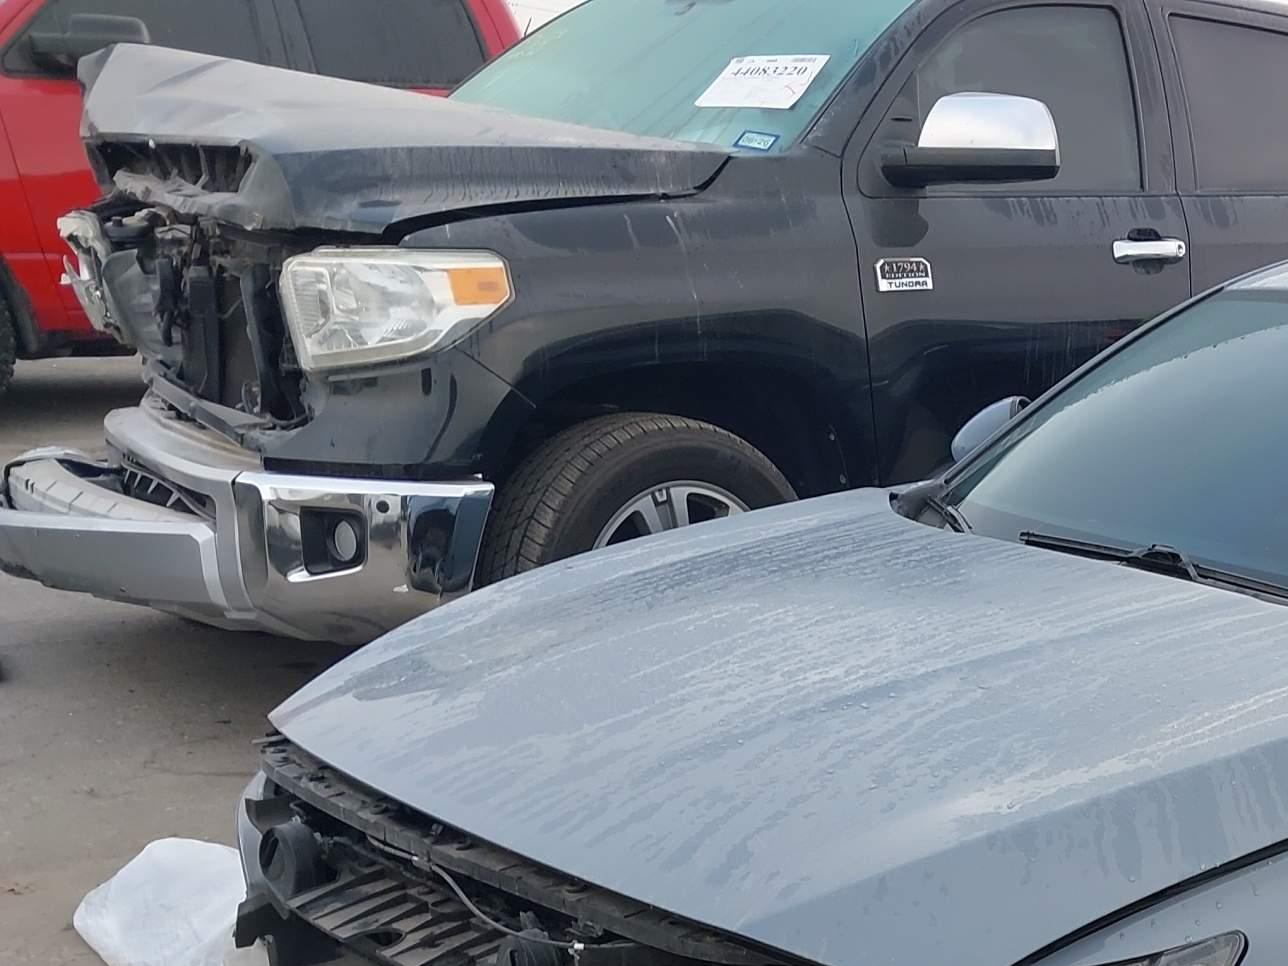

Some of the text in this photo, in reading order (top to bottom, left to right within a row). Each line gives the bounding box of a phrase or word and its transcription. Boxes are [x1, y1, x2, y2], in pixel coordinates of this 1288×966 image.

[730, 65, 808, 77] 44083220
[892, 262, 918, 272] 1794
[887, 280, 929, 289] TUNDRA
